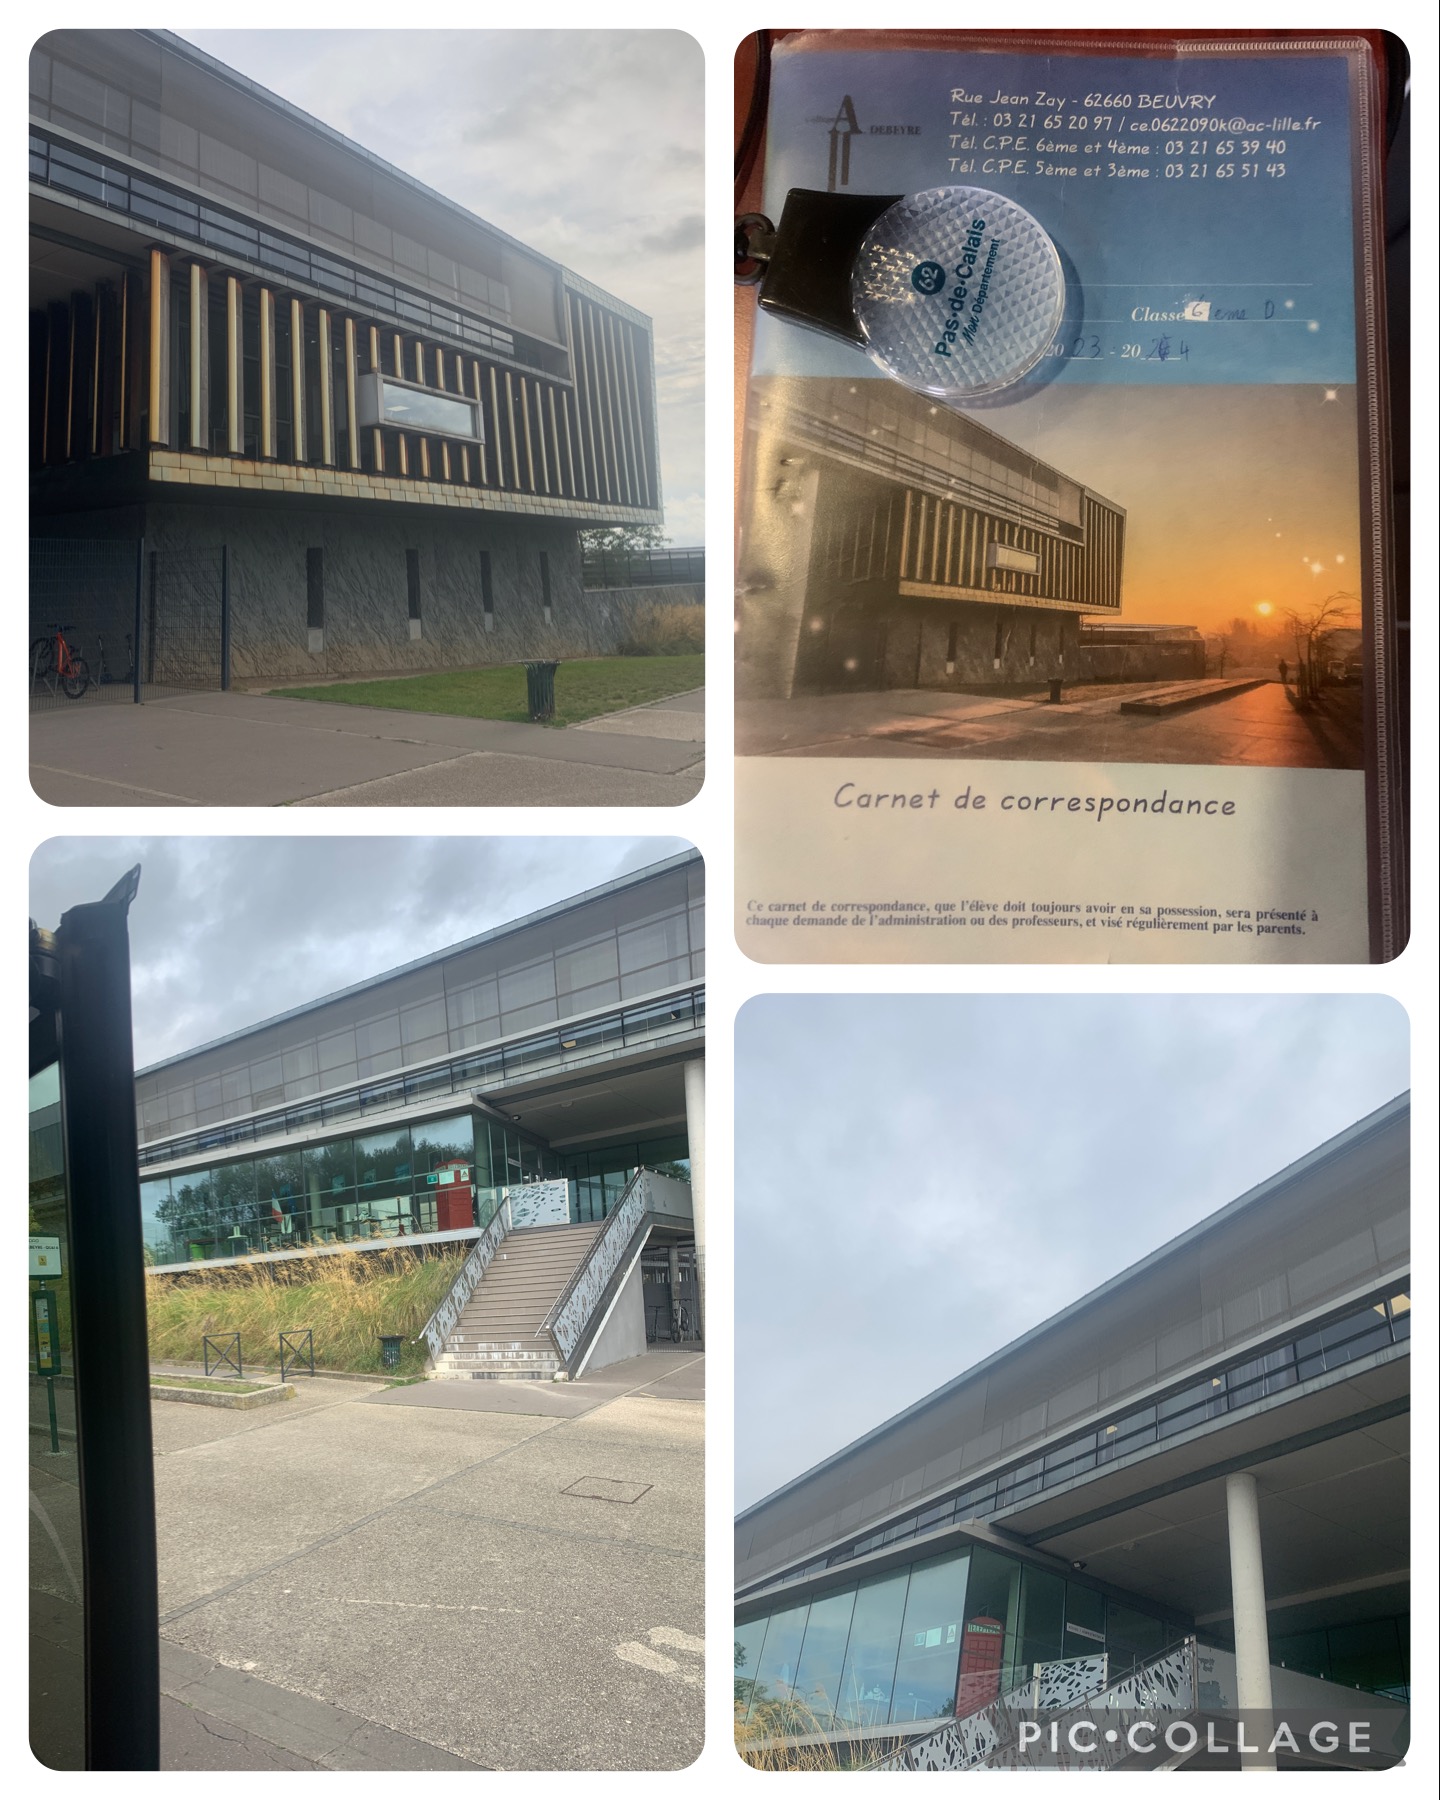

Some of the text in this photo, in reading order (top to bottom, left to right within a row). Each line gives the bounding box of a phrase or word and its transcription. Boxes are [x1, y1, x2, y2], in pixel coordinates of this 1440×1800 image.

[950, 88, 983, 103] Rue
[990, 90, 1029, 105] Jean
[1035, 91, 1066, 112] Zay
[1083, 93, 1132, 108] 62660
[1137, 94, 1216, 109] BEUVRY
[870, 125, 921, 135] DEBEYRE
[950, 111, 978, 127] Tél.
[993, 113, 1012, 127] 03
[1018, 113, 1036, 128] 21
[1043, 114, 1062, 129] 65
[1068, 115, 1088, 130] 20
[1093, 116, 1113, 131] 97
[1118, 116, 1126, 132] /
[1130, 116, 1321, 135] ce.0622090k@ac-lille.fr
[948, 134, 977, 150] Tél.
[983, 136, 1030, 151] C.P.E.
[1036, 138, 1078, 153] 6ème
[1084, 141, 1101, 153] et
[1107, 140, 1150, 154] 4ème
[1165, 141, 1184, 155] 03
[1190, 141, 1208, 155] 21
[1216, 140, 1235, 154] 65
[1241, 140, 1260, 154] 39
[1266, 140, 1286, 154] 40
[948, 157, 977, 173] Tél.
[982, 159, 1029, 174] C.P.E.
[1035, 161, 1078, 176] 5ème
[1083, 165, 1101, 177] et
[1108, 163, 1150, 177] 3ème
[1165, 164, 1184, 178] 03
[1190, 164, 1208, 178] 21
[1216, 164, 1235, 177] 65
[1241, 164, 1259, 177] 51
[1266, 163, 1286, 177] 43
[962, 238, 1001, 346] Mon Département
[1131, 306, 1185, 322] Classe
[1121, 344, 1141, 358] 20
[834, 782, 1237, 822] Carnet de correspondance
[747, 900, 763, 912] Ce
[768, 901, 806, 912] carnet
[812, 901, 826, 912] de
[831, 901, 931, 915] correspondance,
[935, 902, 956, 914] que
[1003, 901, 1026, 912] doit
[1031, 901, 1081, 915] toujours
[1085, 902, 1116, 914] avoir
[1121, 905, 1134, 914] en
[1139, 905, 1152, 915] sa
[1157, 905, 1222, 918] possession,
[1226, 909, 1251, 918] sera
[1256, 908, 1307, 922] présenté
[1311, 910, 1319, 922] à
[746, 915, 1306, 936] chaque demande de l'administration ou des professeurs, et visé régulièrement par les parents.
